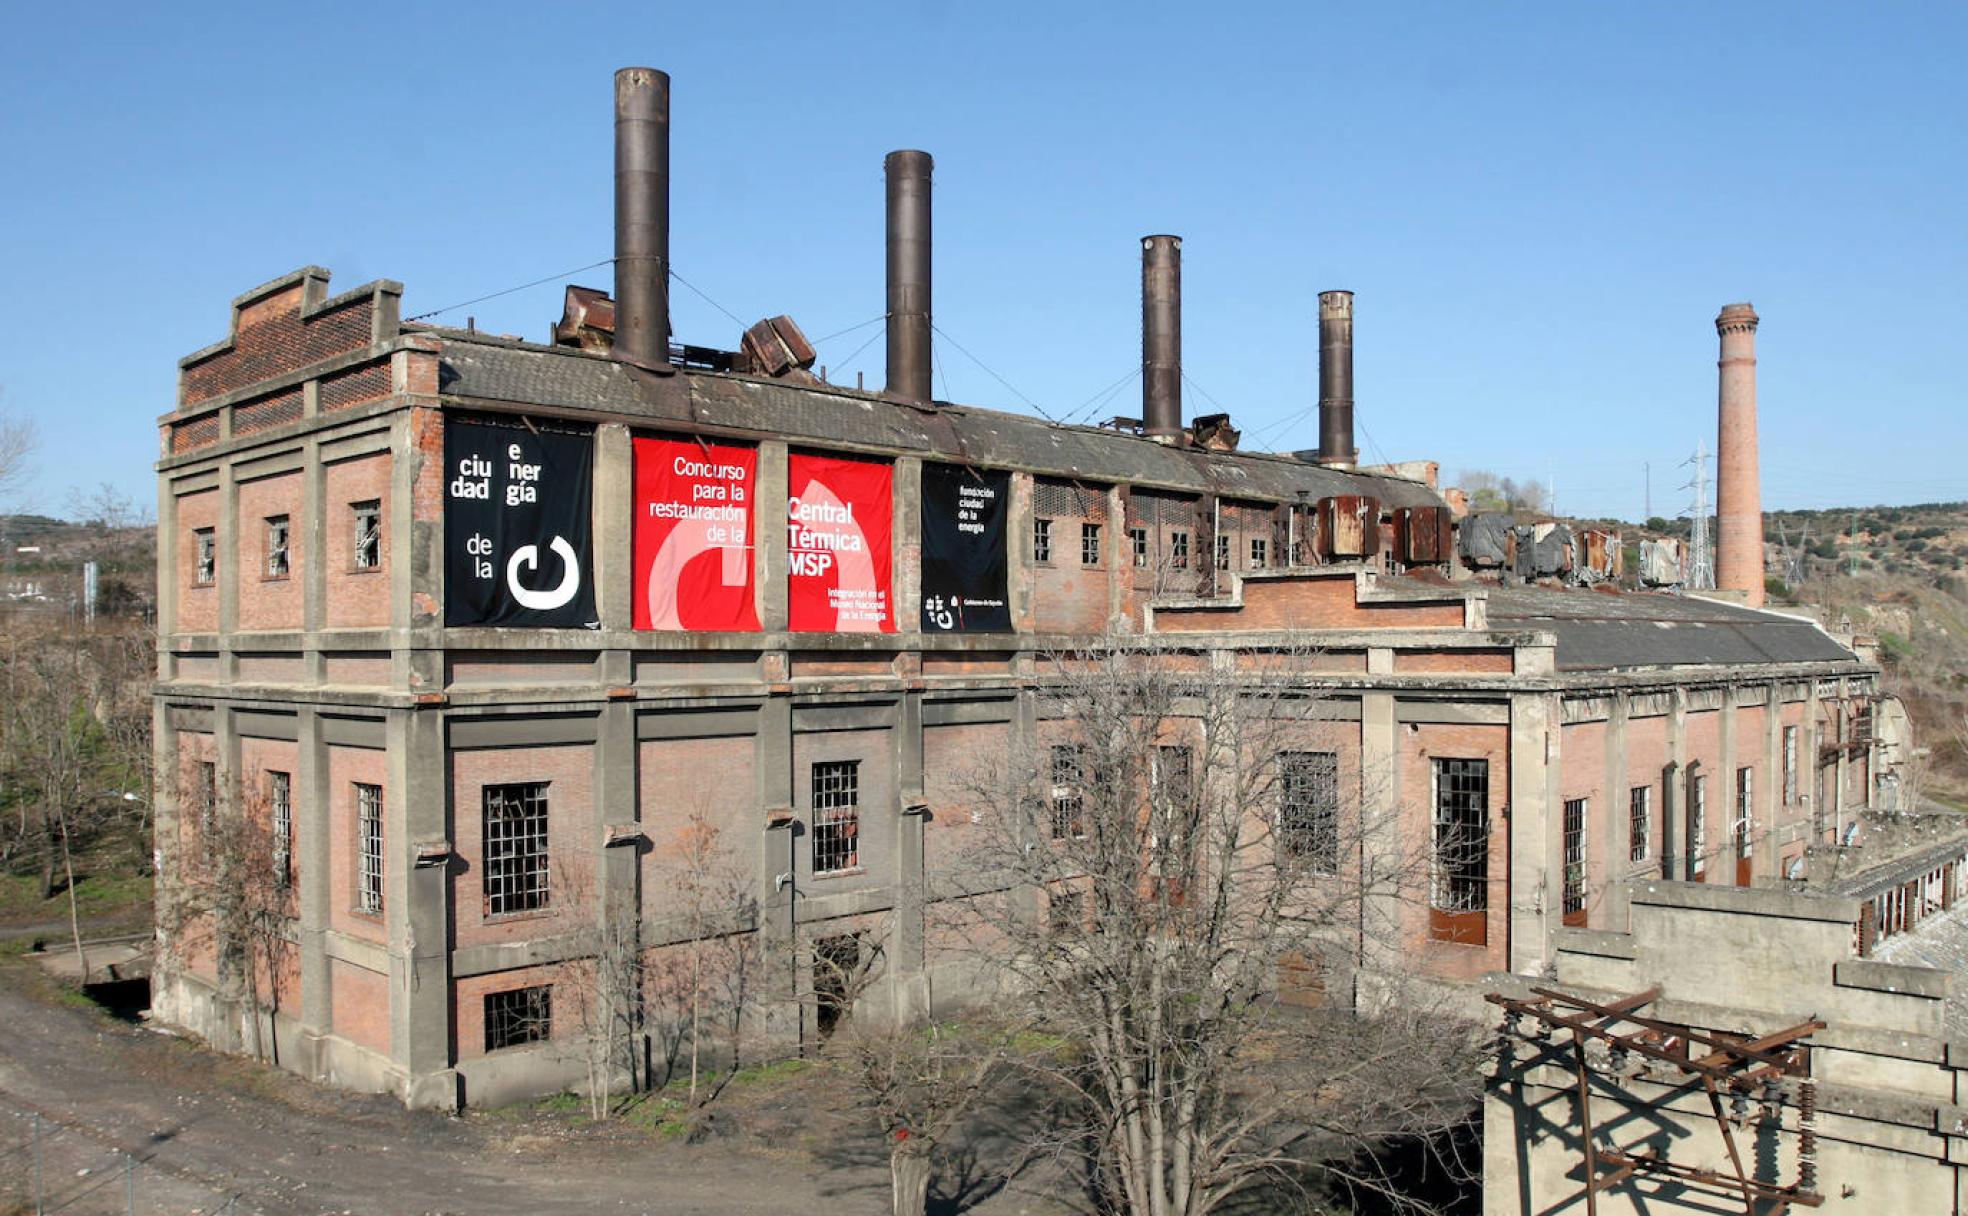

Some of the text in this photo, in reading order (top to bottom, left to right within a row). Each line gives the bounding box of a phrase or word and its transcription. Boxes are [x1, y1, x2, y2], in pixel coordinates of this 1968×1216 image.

[508, 443, 520, 460] e
[459, 454, 492, 477] ciu
[509, 463, 541, 481] ner
[673, 456, 745, 480] Concurso
[450, 476, 489, 499] dad
[506, 481, 536, 506] gía
[693, 483, 744, 502] para la
[649, 500, 744, 521] restauración
[788, 496, 852, 524] Central
[958, 510, 968, 520] de
[466, 533, 492, 554] de
[707, 524, 744, 542] de la
[788, 524, 861, 551] Térmica
[475, 556, 492, 578] la
[787, 552, 832, 577] MSP
